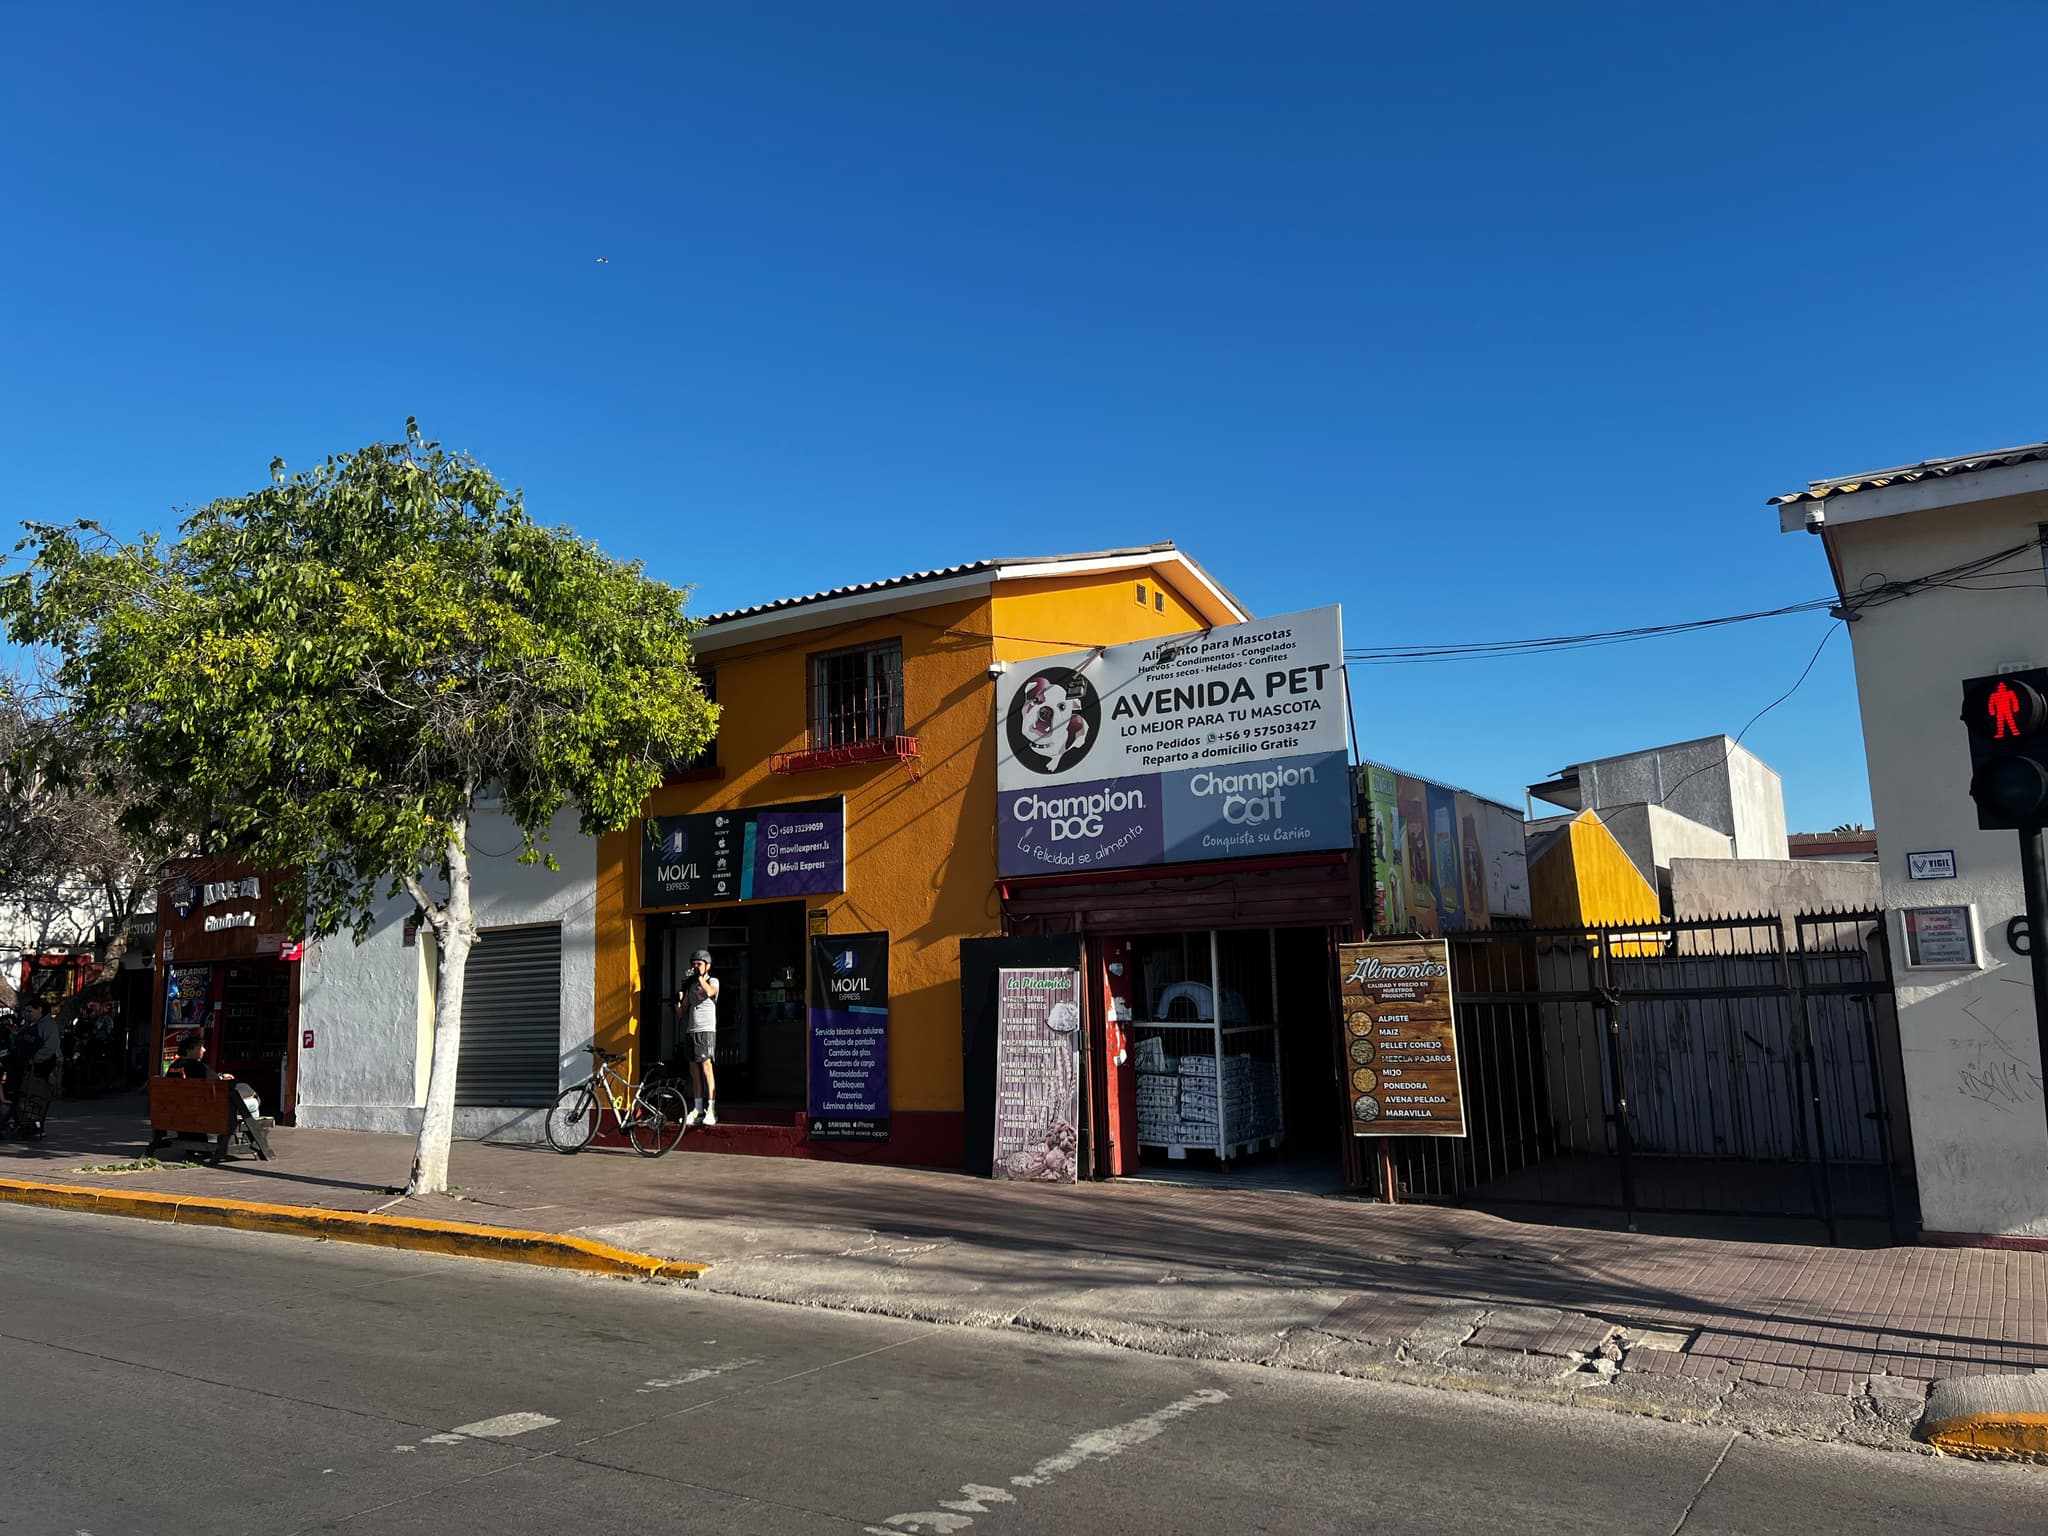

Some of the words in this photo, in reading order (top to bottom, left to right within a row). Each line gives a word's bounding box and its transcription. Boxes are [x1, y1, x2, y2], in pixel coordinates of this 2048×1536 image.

[1138, 662, 1170, 674] Huevos
[1176, 652, 1234, 667] Condimentos
[1242, 641, 1296, 657] Congelados
[1142, 645, 1198, 662] Alinto
[1202, 640, 1230, 654] para
[1232, 629, 1292, 646] Mascotas
[1146, 670, 1174, 682] Frutos
[1176, 668, 1199, 678] secos
[1206, 661, 1242, 672] Helados
[1249, 654, 1288, 665] Confites
[1111, 677, 1255, 720] AVENIDA
[1266, 664, 1330, 697] PET
[1121, 725, 1137, 737] LO
[1141, 718, 1184, 734] MEJOR
[1187, 712, 1225, 730] PARA
[1229, 709, 1247, 722] TU
[1252, 699, 1321, 719] MASCOTA
[1126, 742, 1153, 754] Fono
[1156, 736, 1201, 750] Pedidos
[1218, 729, 1240, 742] +56
[1243, 729, 1250, 739] 9
[1254, 720, 1317, 737] 57503427
[1142, 751, 1189, 766] Reparto
[1202, 742, 1257, 758] domicilio
[1261, 737, 1299, 751] Gratis
[1190, 765, 1315, 796] Champion
[1014, 788, 1143, 821] Champion
[1223, 787, 1286, 826] Cat
[1051, 816, 1104, 841] DOG
[1202, 830, 1255, 853] Conquista
[1258, 832, 1270, 842] su
[1273, 827, 1311, 841] Cariño
[1017, 836, 1030, 853] La
[1034, 846, 1074, 865] felicidad
[1078, 854, 1092, 864] se
[1096, 824, 1143, 859] alimenta
[657, 863, 700, 882] MOVIL
[800, 861, 825, 872] Express
[1928, 859, 1950, 868] VIGIL
[666, 881, 690, 891] EXPRESS
[832, 978, 870, 992] MOVIL
[1008, 977, 1020, 989] La
[1023, 977, 1071, 989] Piramide
[1344, 958, 1446, 984] Alimentos
